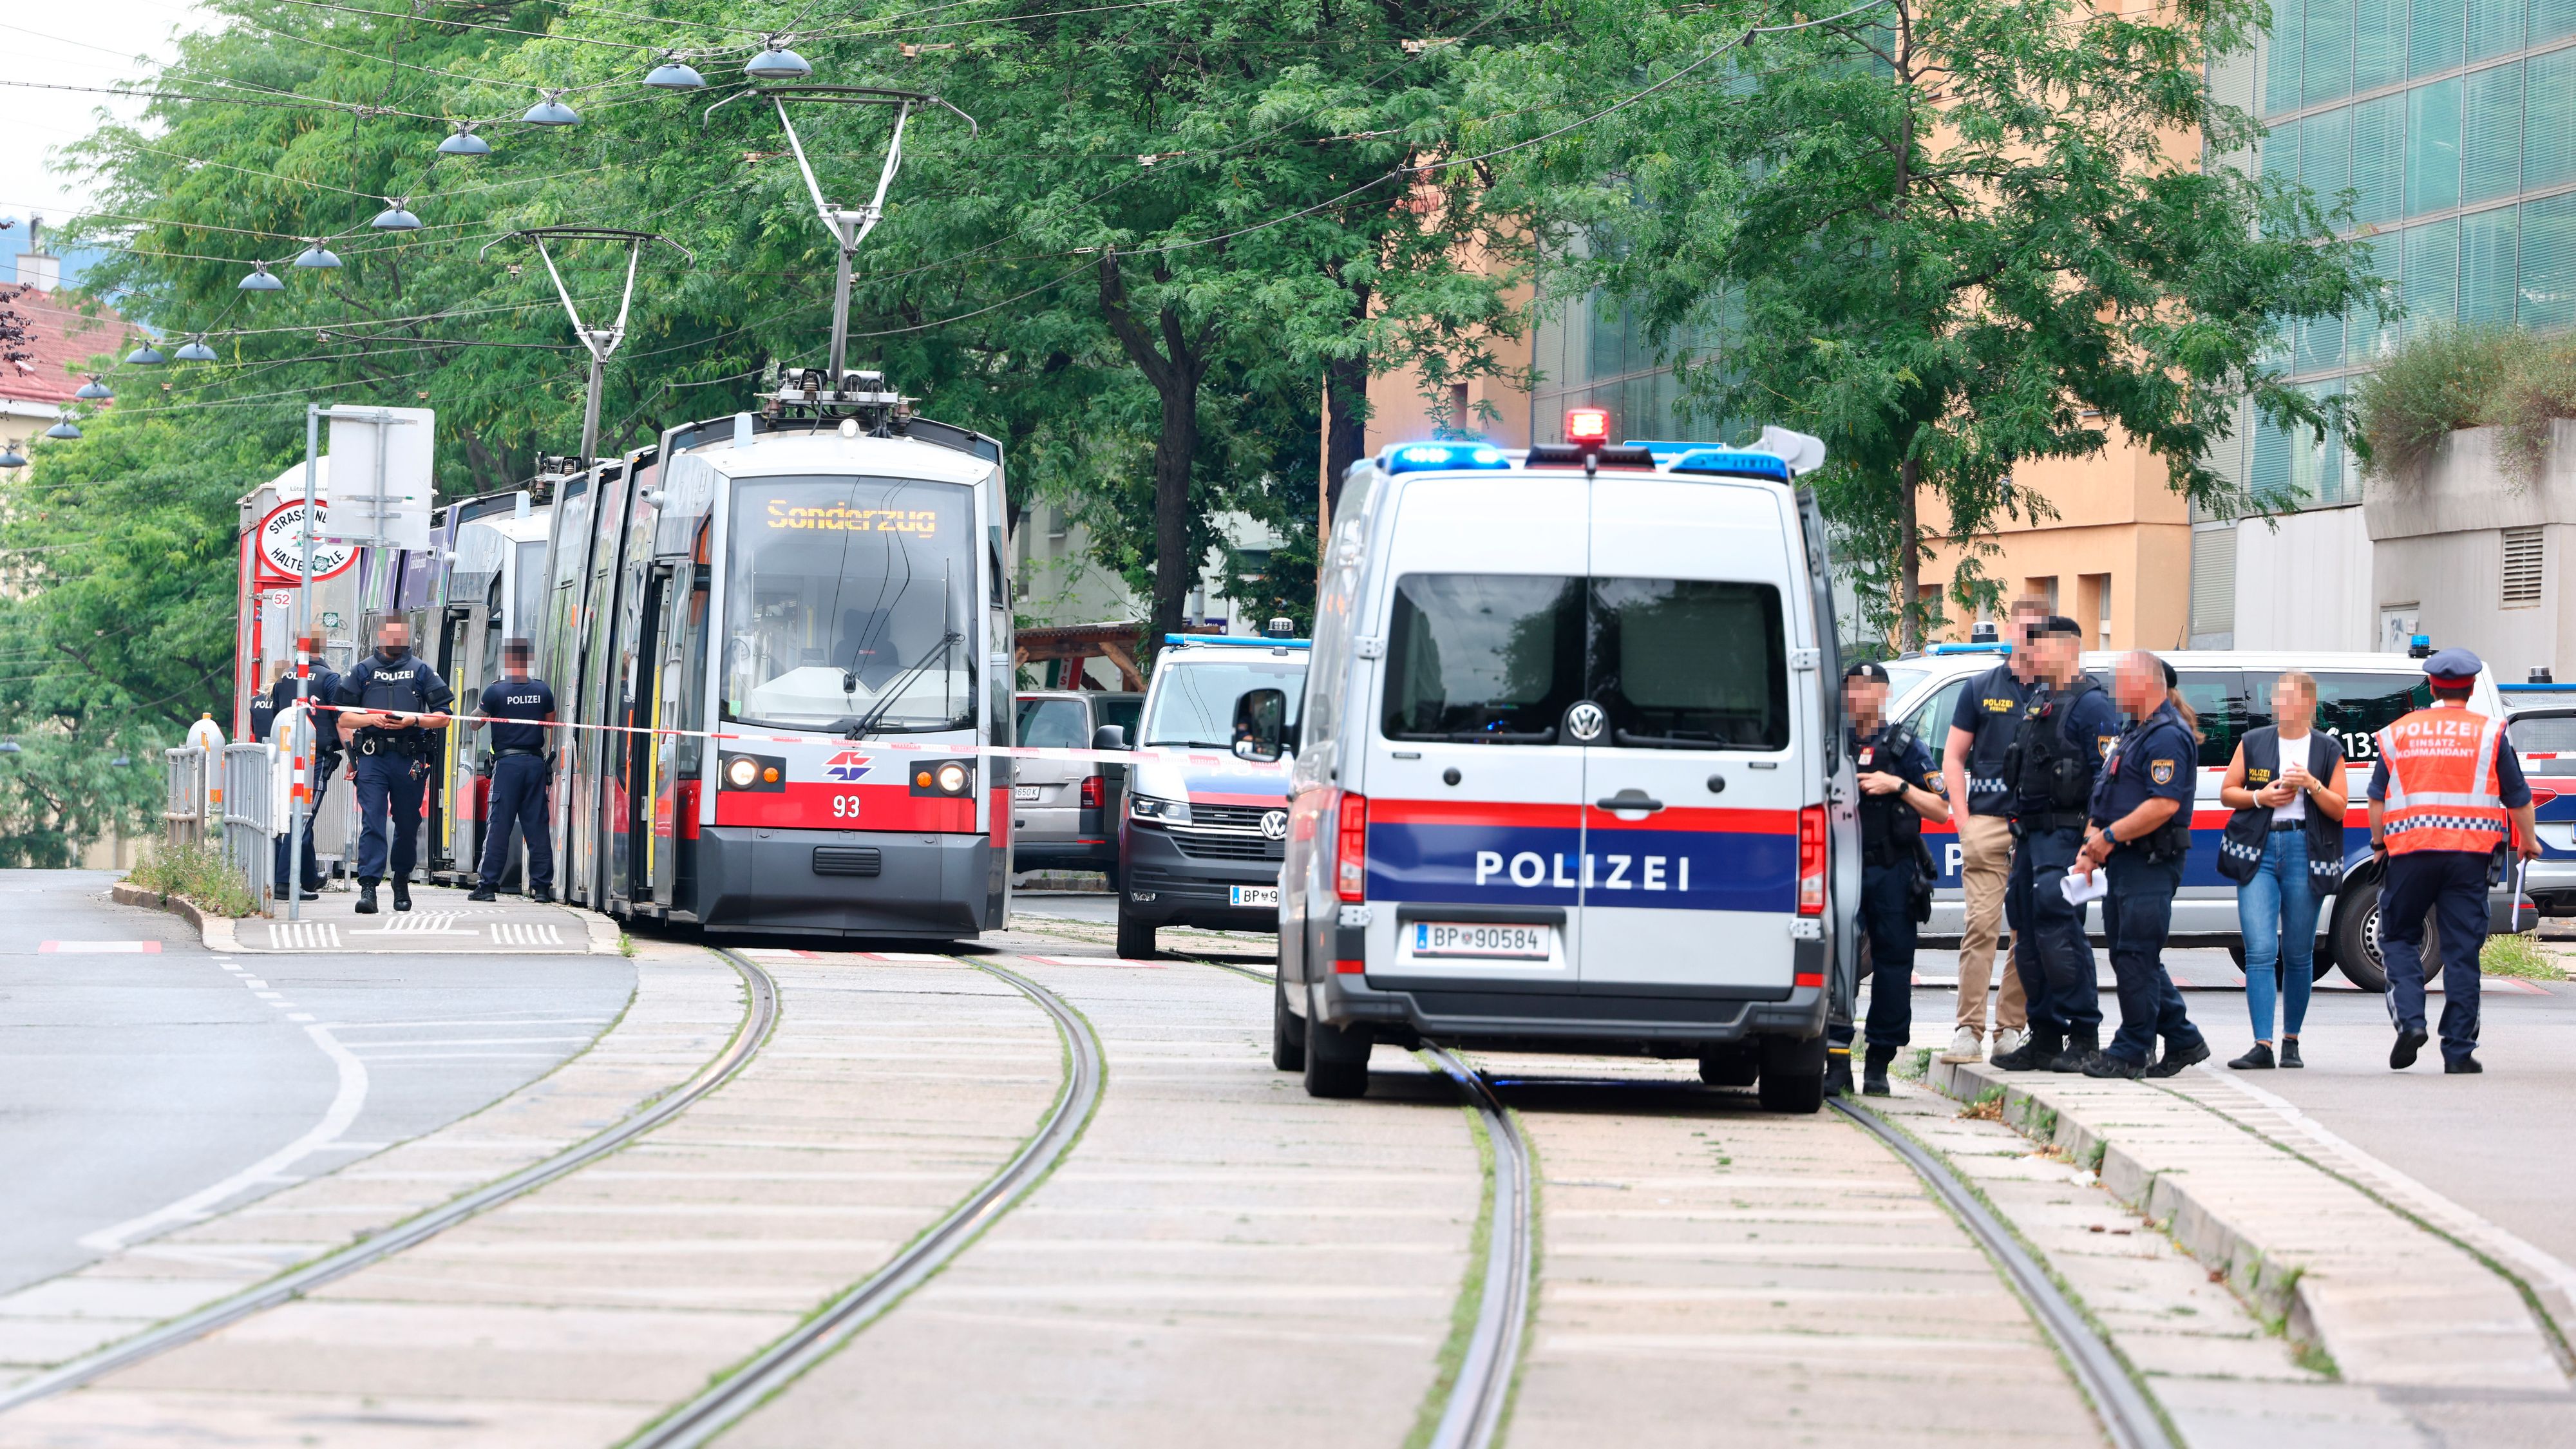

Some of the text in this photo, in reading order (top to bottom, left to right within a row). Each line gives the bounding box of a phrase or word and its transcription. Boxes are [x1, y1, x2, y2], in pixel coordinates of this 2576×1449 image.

[768, 500, 935, 538] Sonderzug
[274, 594, 289, 605] 52
[374, 670, 414, 681] POLIZEI
[507, 695, 540, 705] POLIZEI
[1983, 699, 2013, 708] POLIZEI
[2395, 721, 2478, 739] POLIZEI
[2396, 748, 2474, 759] KOMMANDANT
[2249, 768, 2270, 777] POLIZEI
[833, 795, 860, 818] 93
[1945, 843, 1964, 876] P
[1475, 851, 1689, 891] POLIZEI
[1244, 890, 1260, 902] BP
[1270, 891, 1278, 903] 9
[1434, 928, 1458, 947] BP
[1475, 929, 1538, 949] 90584
